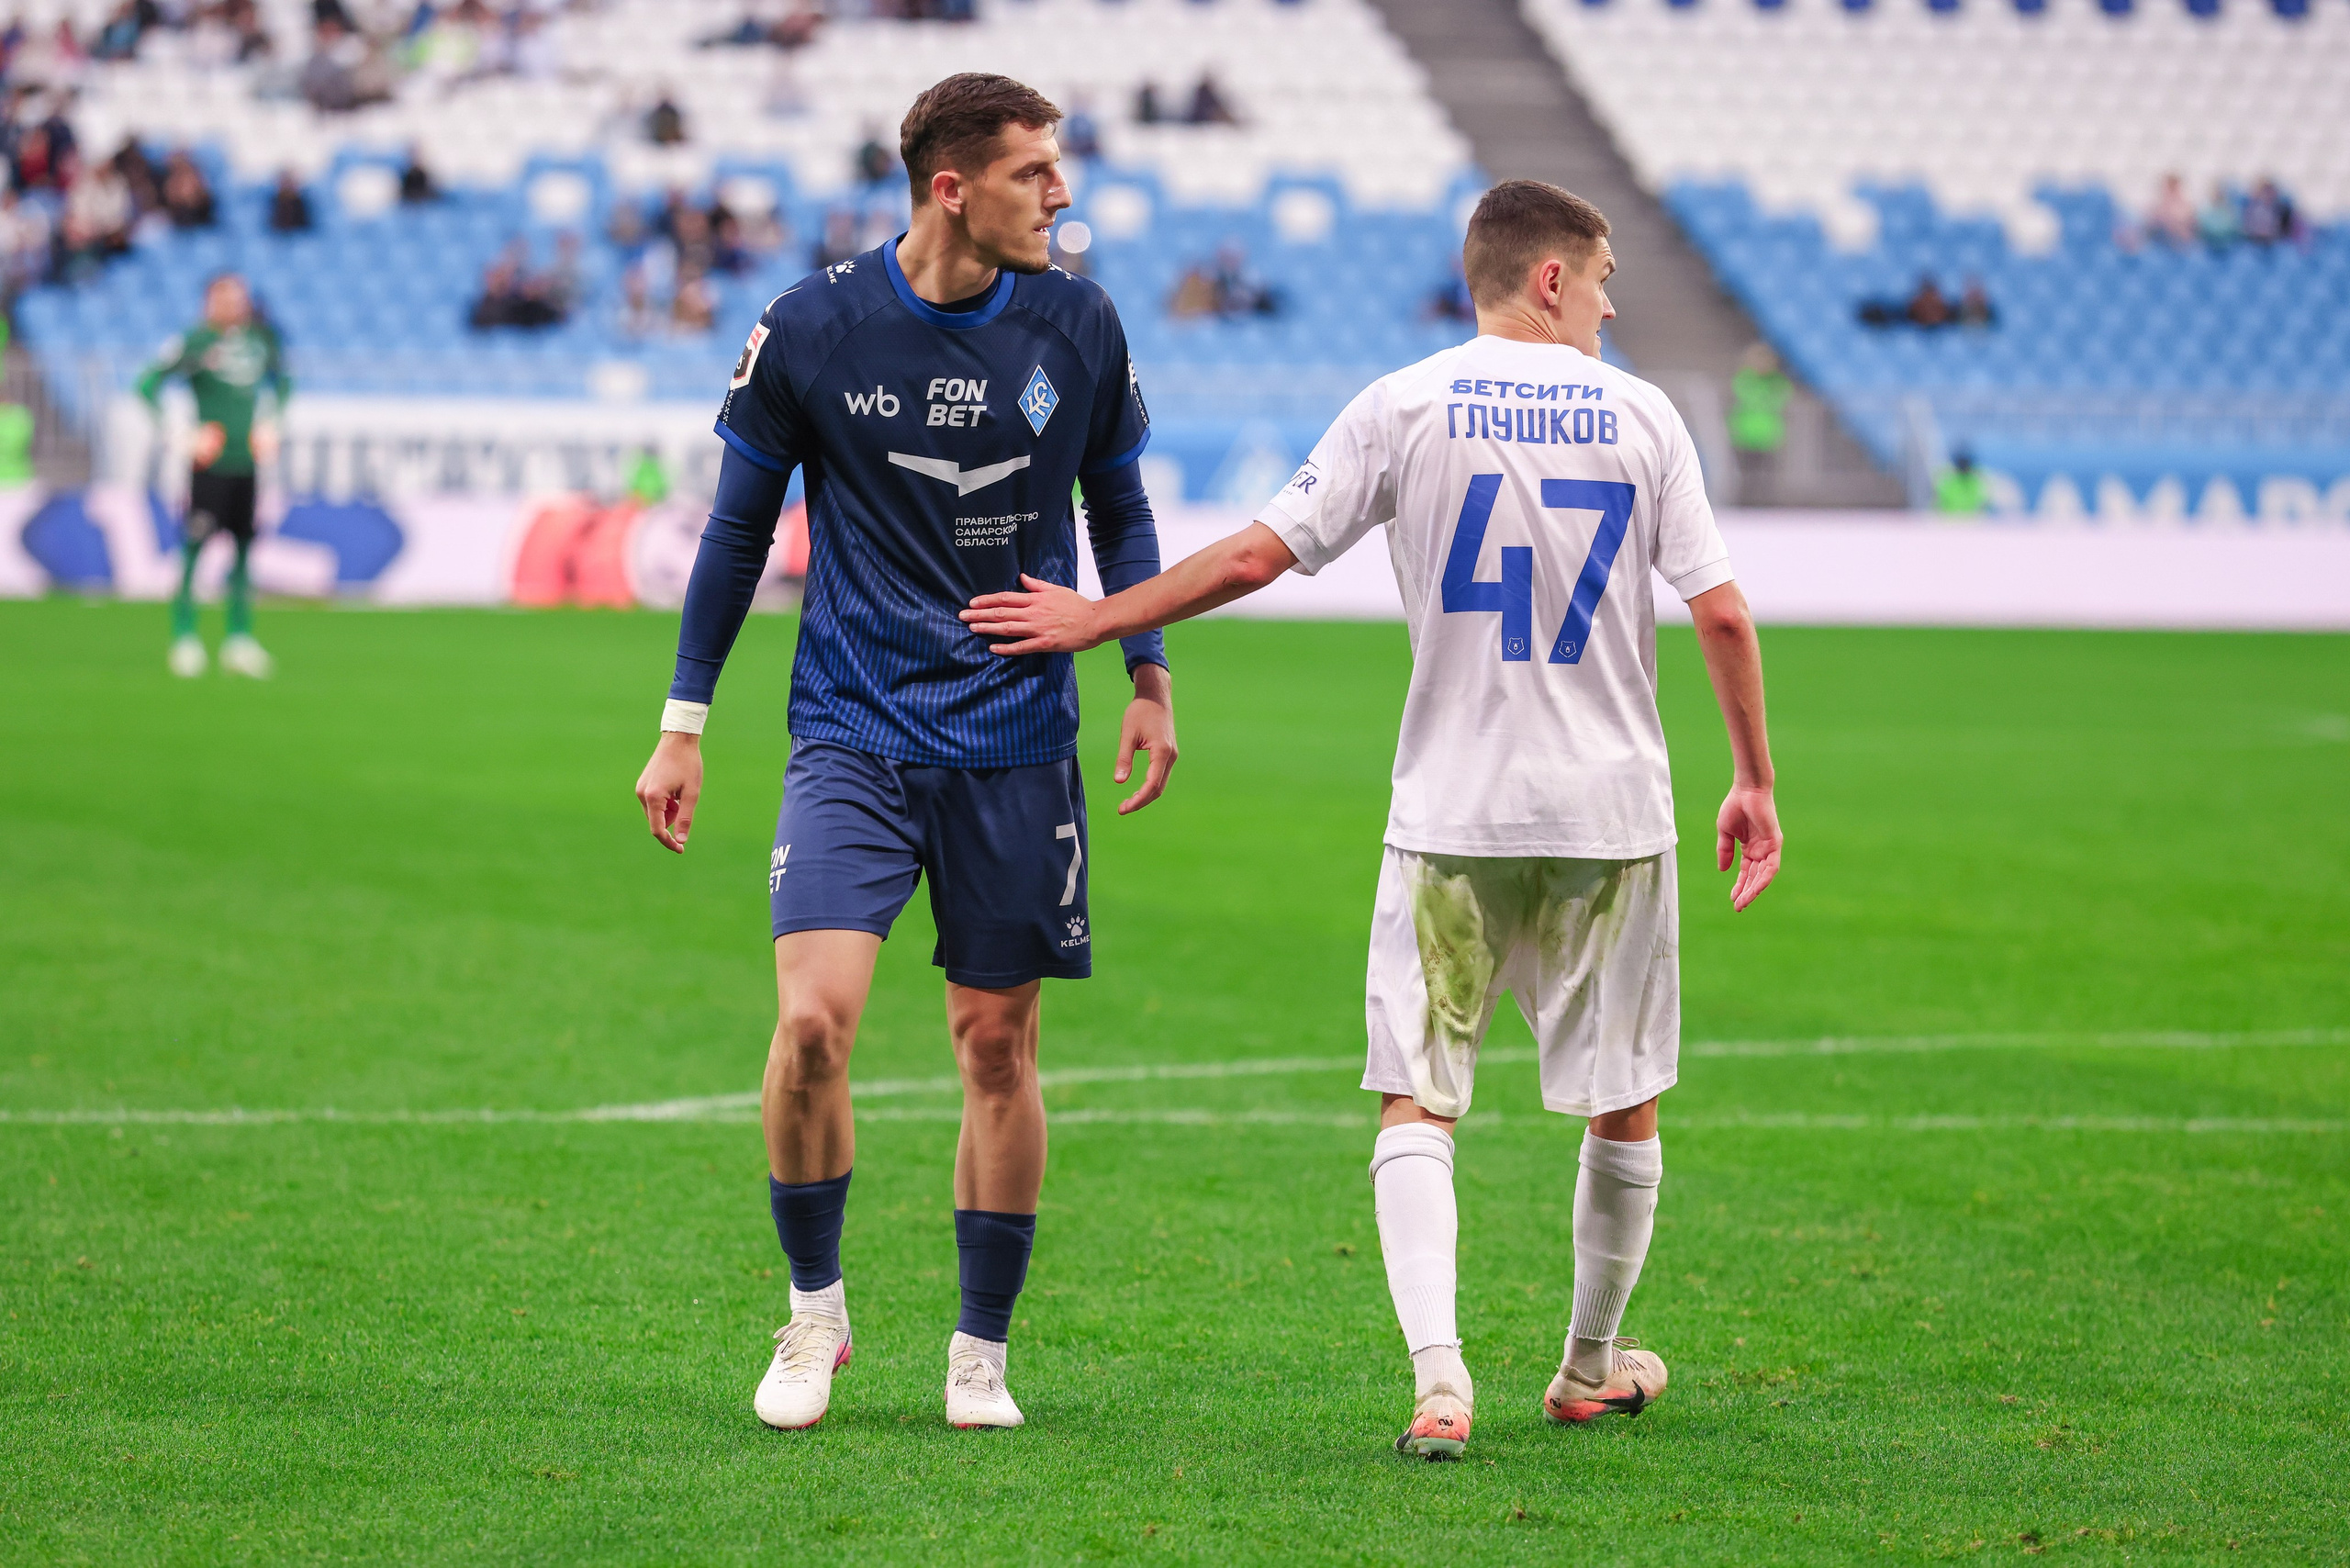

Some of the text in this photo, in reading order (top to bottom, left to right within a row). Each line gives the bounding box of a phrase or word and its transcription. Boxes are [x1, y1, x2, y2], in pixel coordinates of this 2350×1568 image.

[826, 264, 837, 285] ELME
[844, 385, 901, 418] wb
[926, 377, 989, 402] FON
[1449, 379, 1604, 401] БЕТСИТИ
[925, 404, 988, 428] BET
[1447, 402, 1618, 446] ГЛУШКОВ
[955, 511, 1039, 526] ПРАВИТЕЛЬСТВО
[955, 522, 1018, 536] САМАРСКОЙ
[955, 536, 1009, 547] ОБЛАСТИ
[1440, 473, 1637, 665] 47
[770, 844, 791, 870] ON
[1056, 822, 1082, 907] 7
[768, 868, 787, 895] ET
[1060, 935, 1091, 948] KELME
